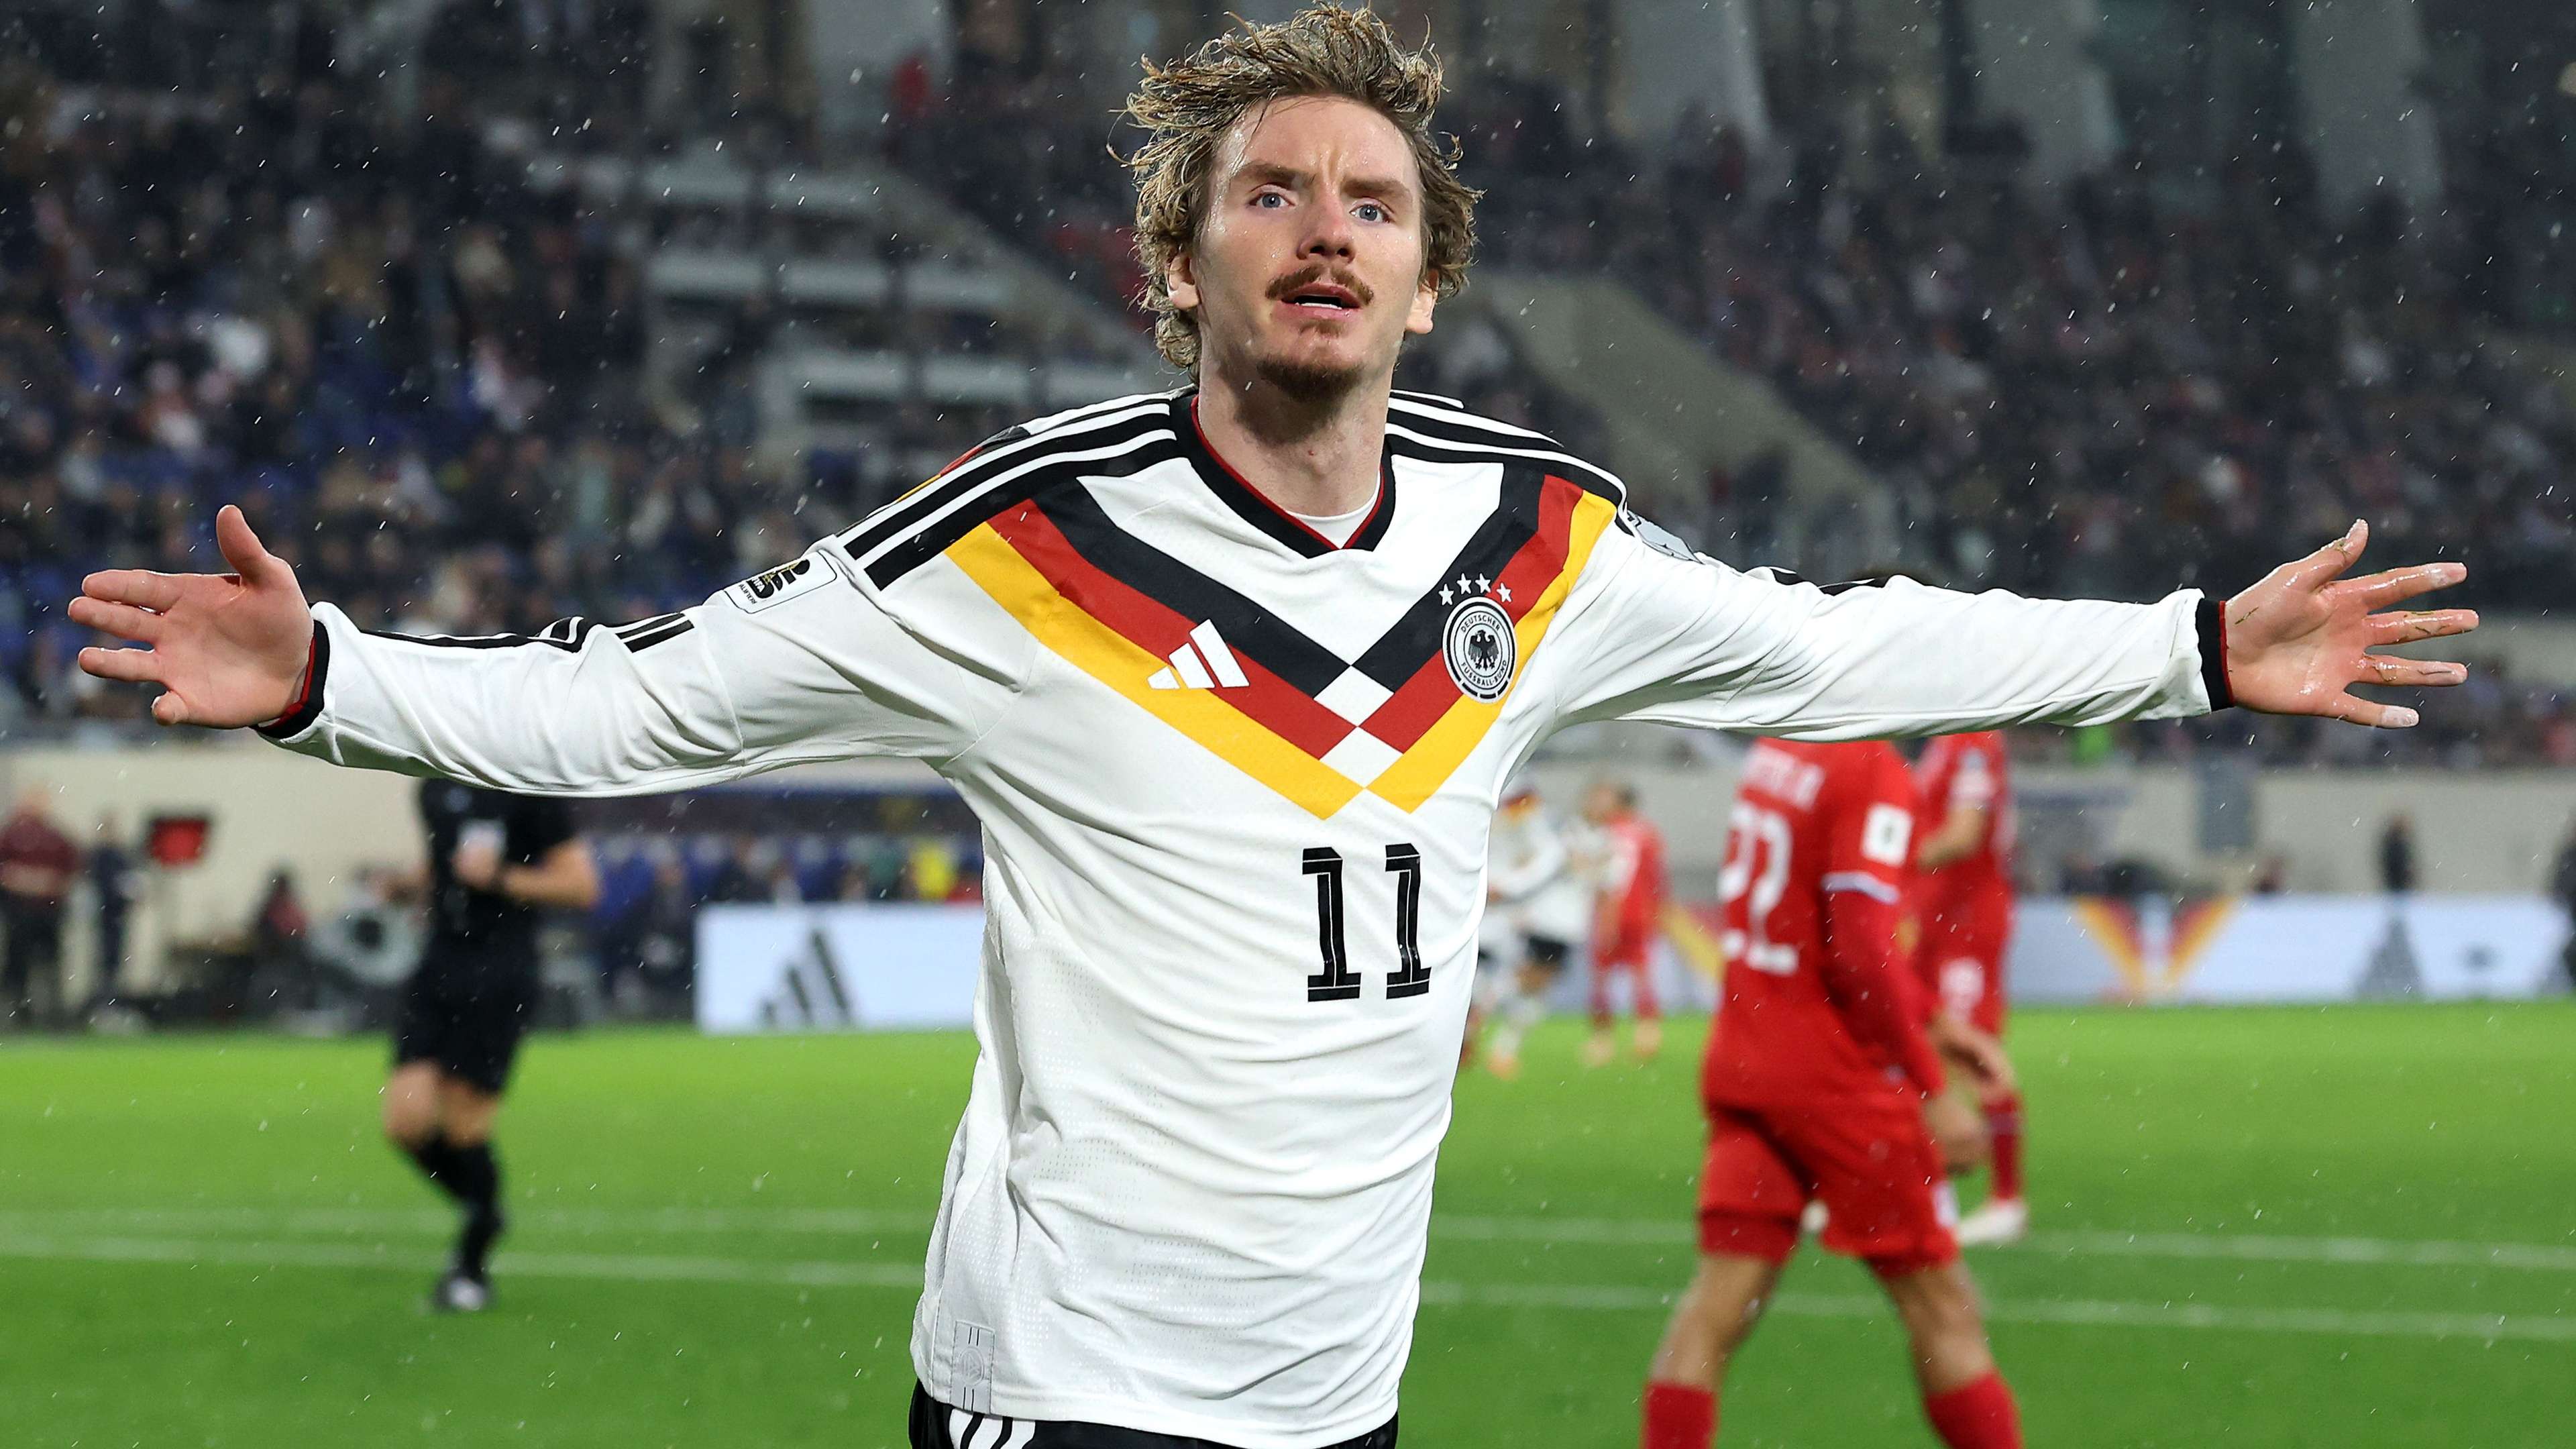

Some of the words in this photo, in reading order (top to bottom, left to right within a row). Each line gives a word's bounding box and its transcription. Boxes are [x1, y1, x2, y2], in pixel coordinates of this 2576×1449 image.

[1460, 614, 1501, 633] DEUTSCHER
[1461, 660, 1507, 686] FUSSBALL-BUND
[1302, 843, 1432, 1002] 11
